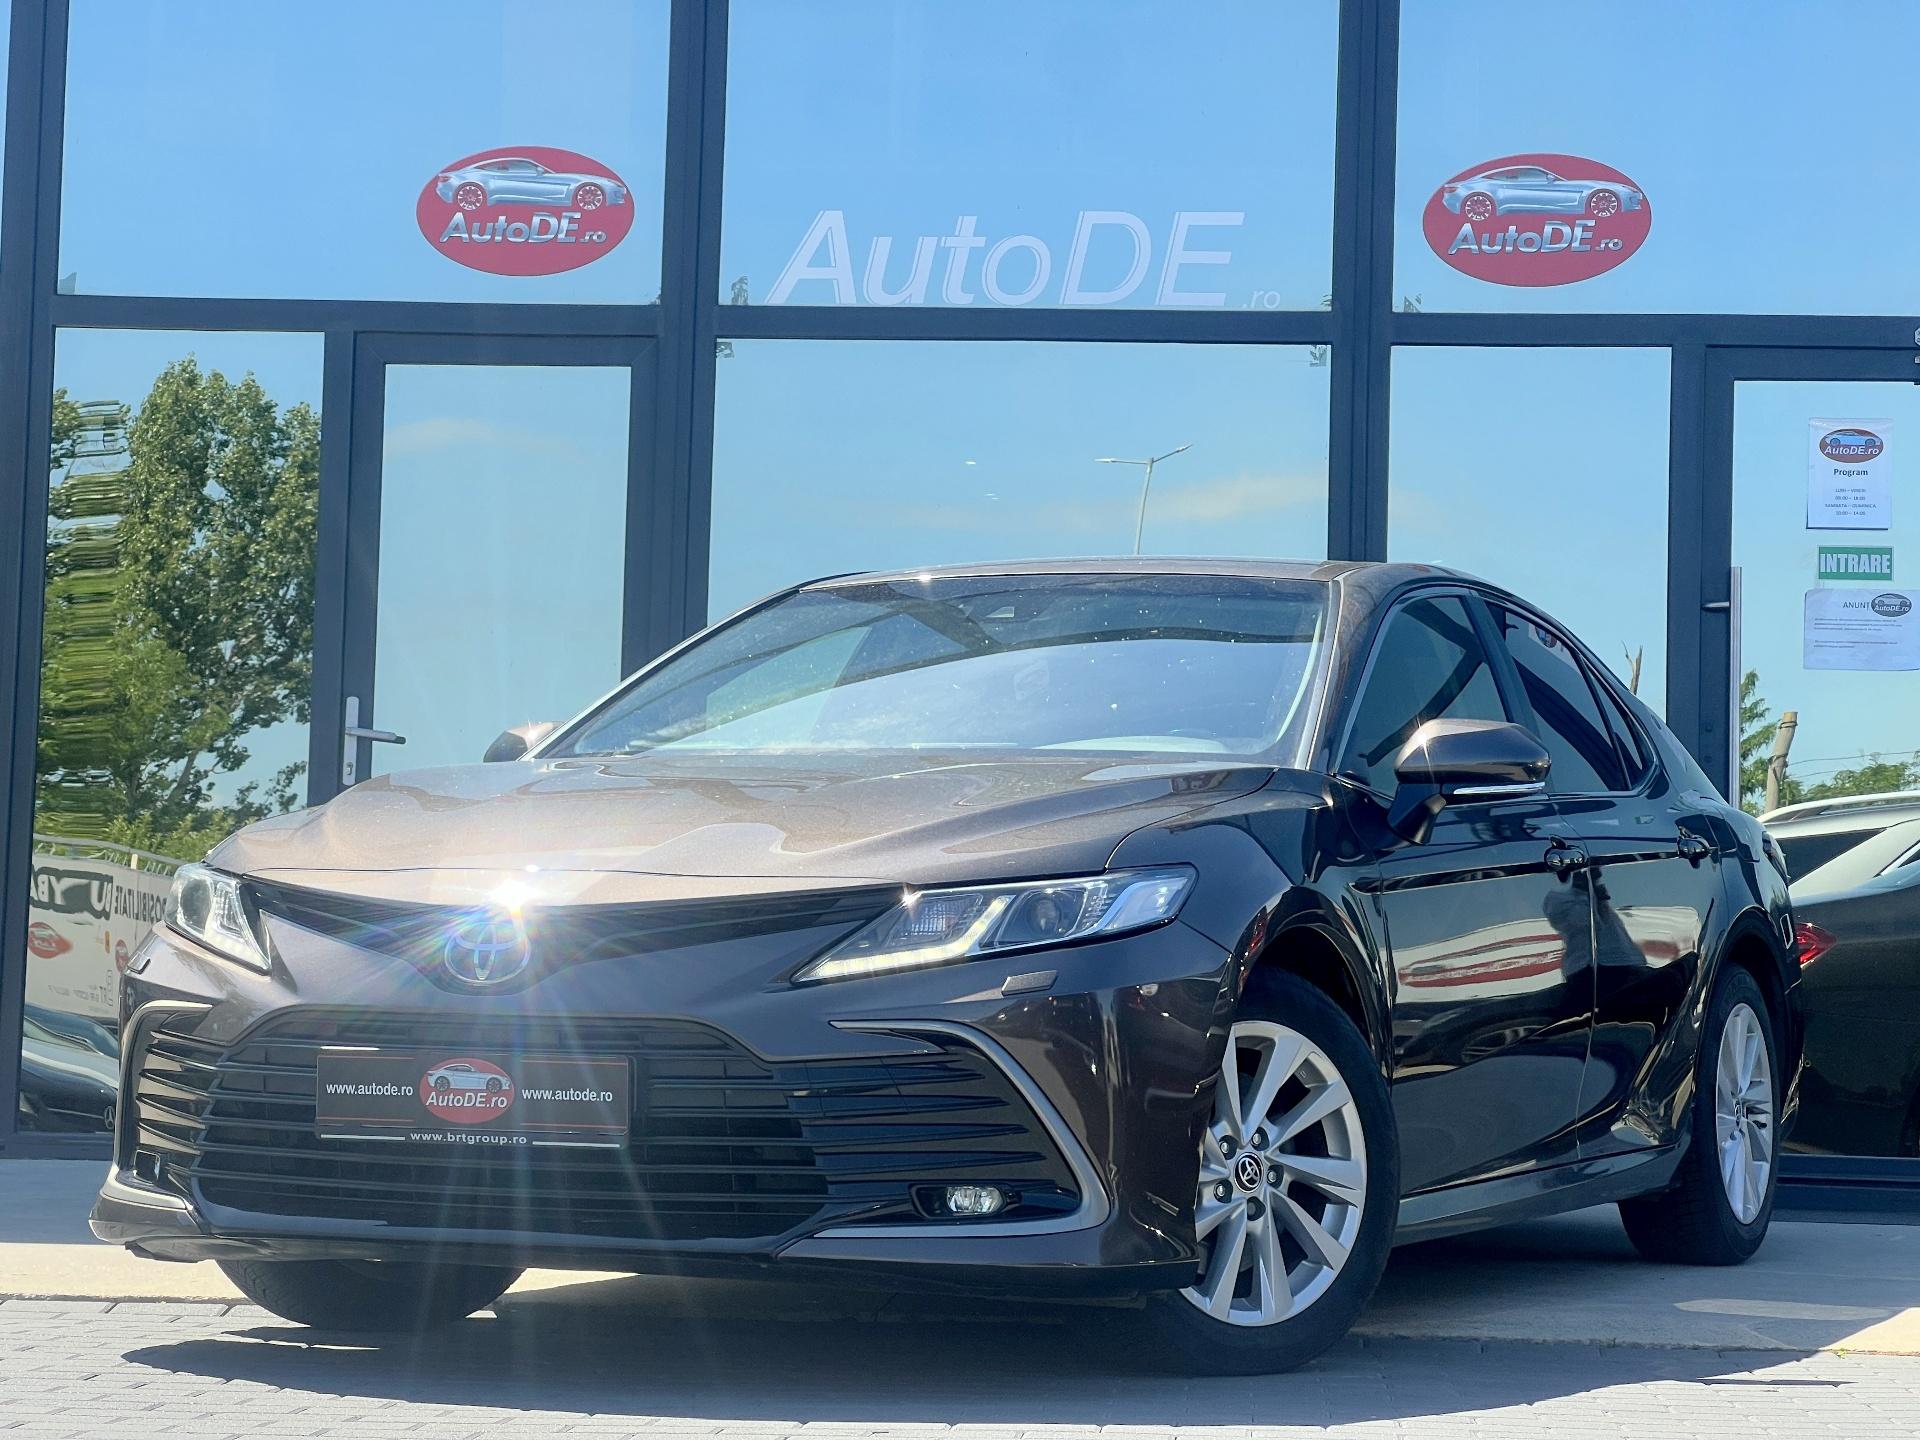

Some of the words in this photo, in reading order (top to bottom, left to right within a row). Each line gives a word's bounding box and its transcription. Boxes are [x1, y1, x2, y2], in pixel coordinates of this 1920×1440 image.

[1824, 445, 1880, 455] AutoDE.ro
[1833, 468, 1869, 477] Program
[1819, 553, 1891, 574] INTRARE
[326, 1082, 414, 1097] www.autode.ro
[521, 1087, 613, 1103] www.autode.ro
[425, 1091, 509, 1109] AutoDE.ro
[410, 1131, 527, 1146] www.brtgroup.ro
